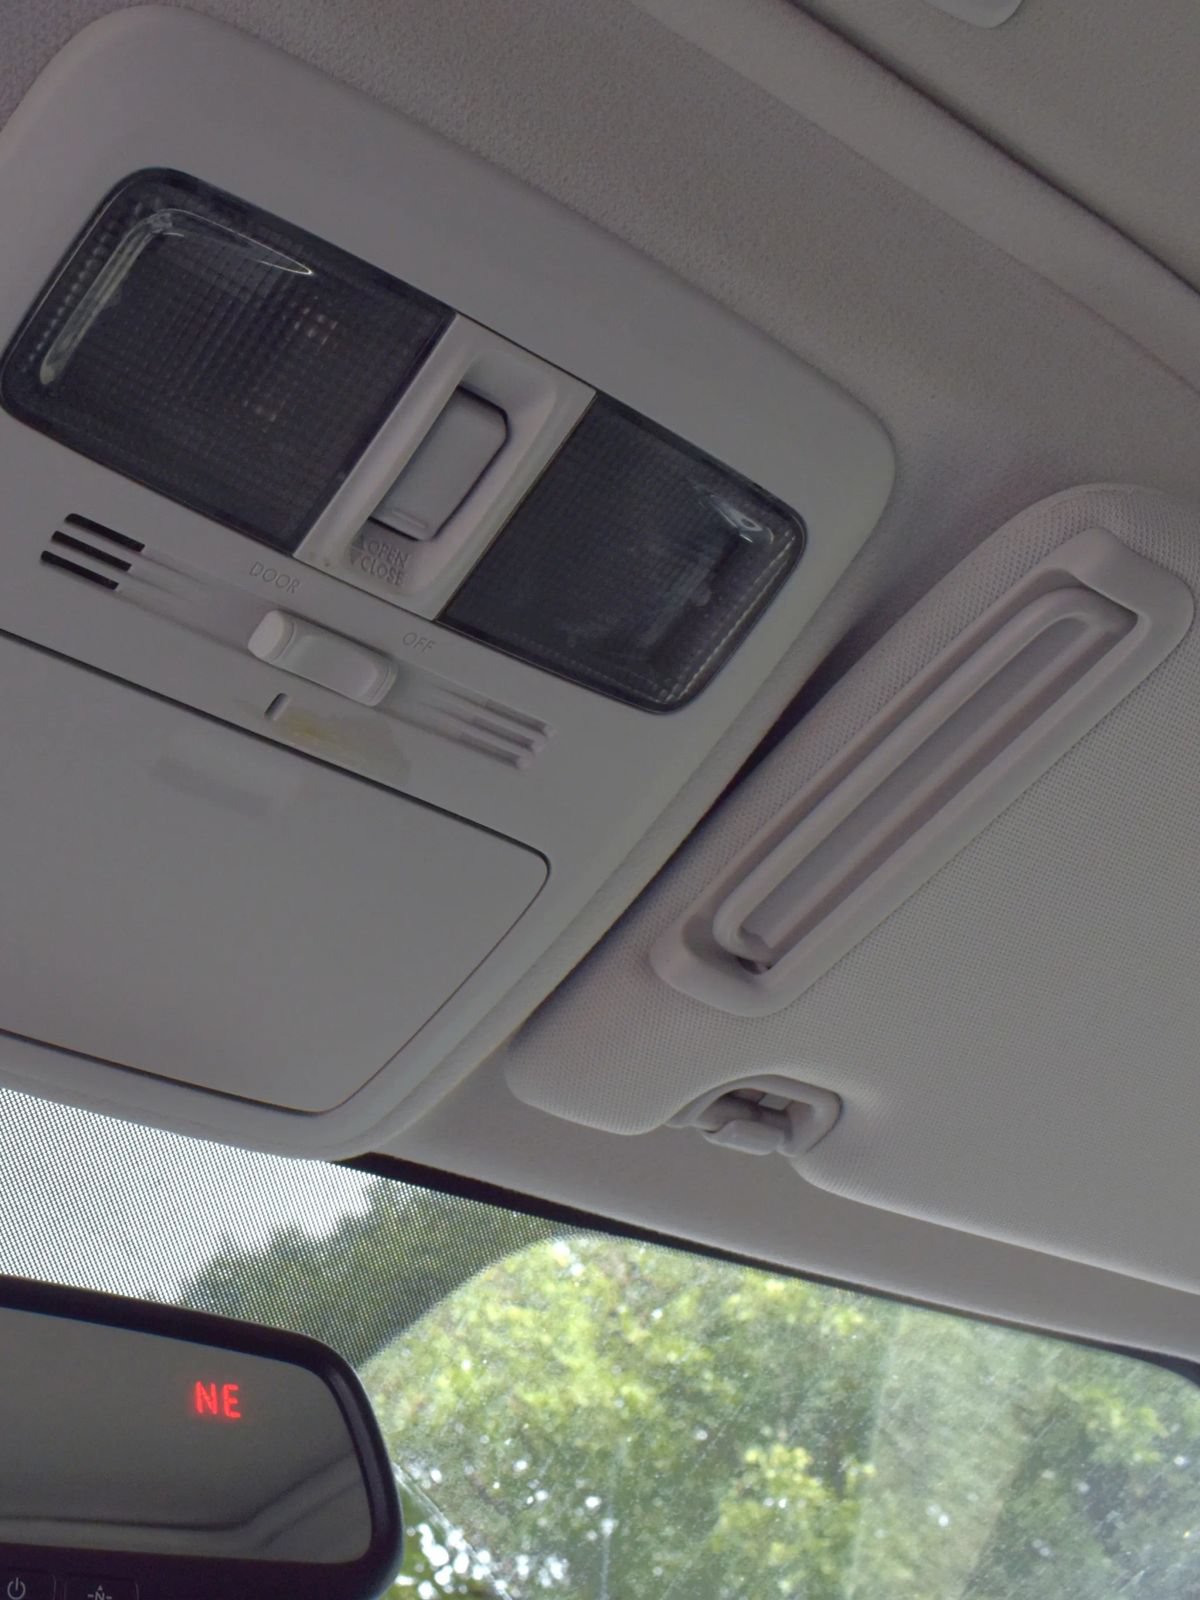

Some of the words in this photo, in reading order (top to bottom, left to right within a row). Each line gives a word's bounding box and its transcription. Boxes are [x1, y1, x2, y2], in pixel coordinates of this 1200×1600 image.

[367, 539, 411, 569] OPEN
[249, 560, 301, 594] DOOR
[360, 555, 408, 586] CLOSE
[401, 631, 437, 652] OFF
[194, 1380, 242, 1419] NE
